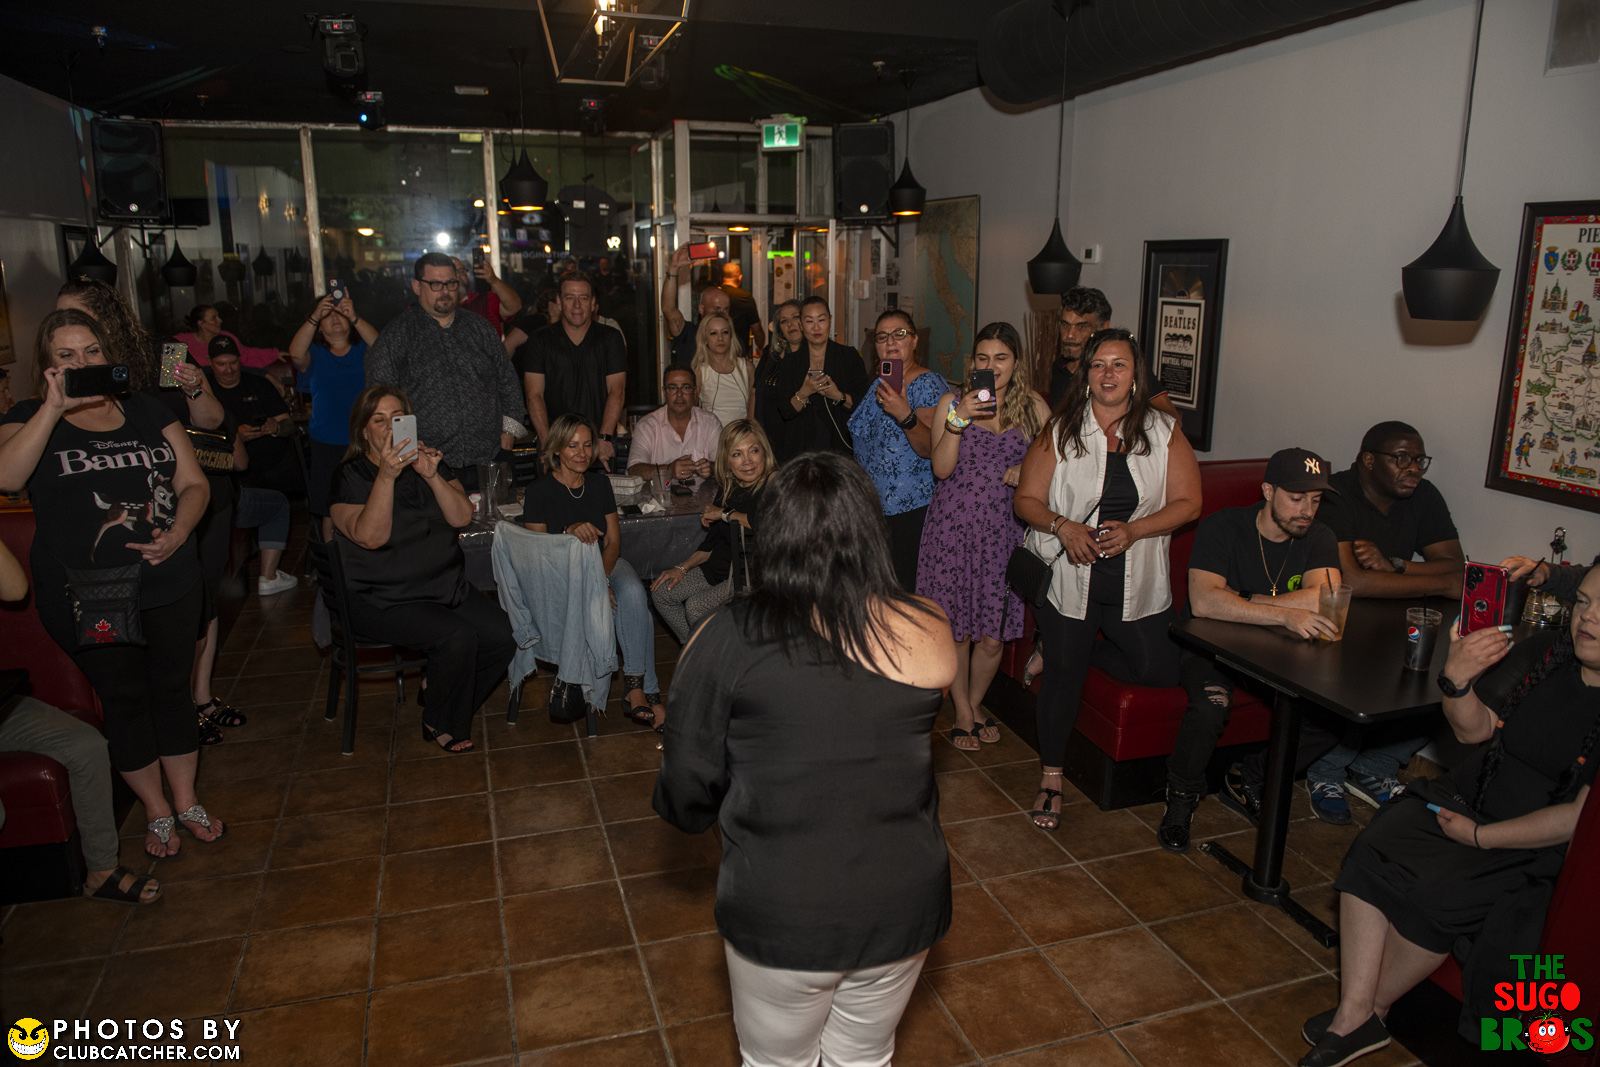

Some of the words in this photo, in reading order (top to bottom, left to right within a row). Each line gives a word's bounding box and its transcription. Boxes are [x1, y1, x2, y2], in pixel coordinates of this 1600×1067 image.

[1164, 315, 1196, 330] BEATLES
[89, 440, 139, 449] Disney
[54, 441, 176, 476] Bambi
[1304, 457, 1321, 474] NY
